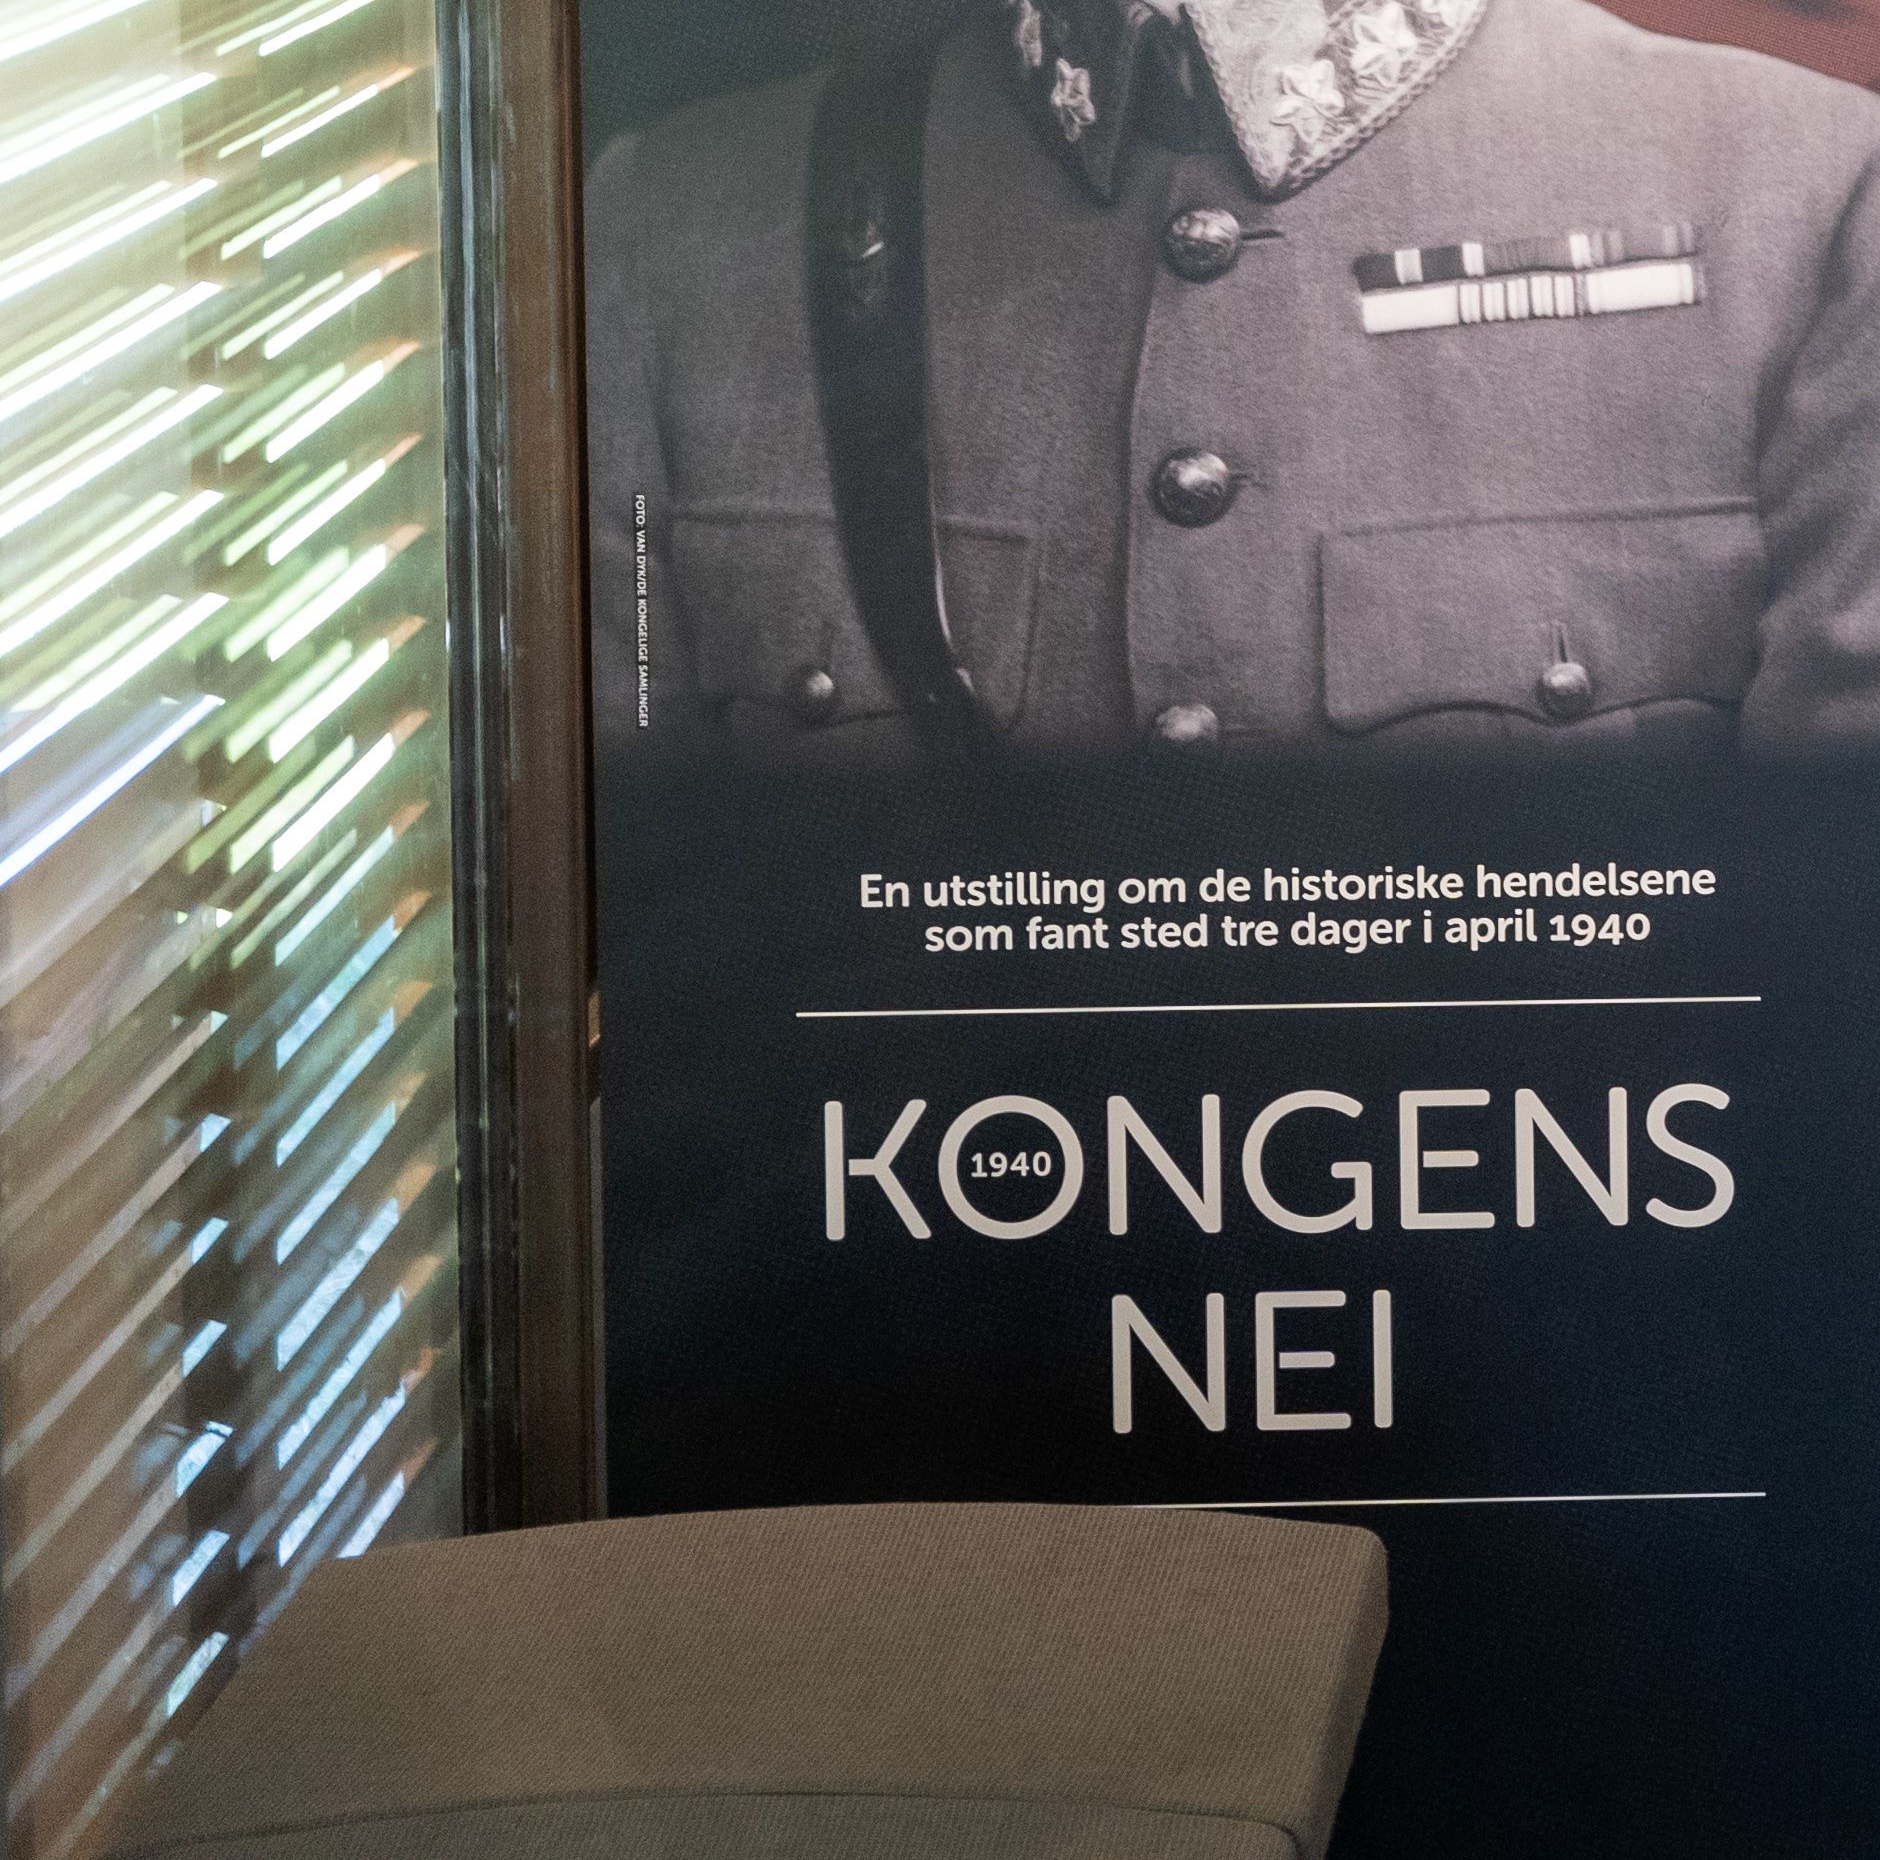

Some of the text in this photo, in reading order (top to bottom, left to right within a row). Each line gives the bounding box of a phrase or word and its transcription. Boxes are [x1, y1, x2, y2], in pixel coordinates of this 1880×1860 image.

[635, 494, 647, 528] FOTO:
[636, 530, 647, 554] VAN
[637, 598, 649, 662] KONGELIGE
[638, 664, 649, 727] SAMLINGER
[860, 861, 1717, 914] En utstilling om de historiske hendelsene
[924, 907, 1651, 954] som fant sted tre dager i april 1940
[824, 1082, 1736, 1241] KONGENS
[969, 1151, 1052, 1178] 1940
[1111, 1289, 1394, 1434] NEI
